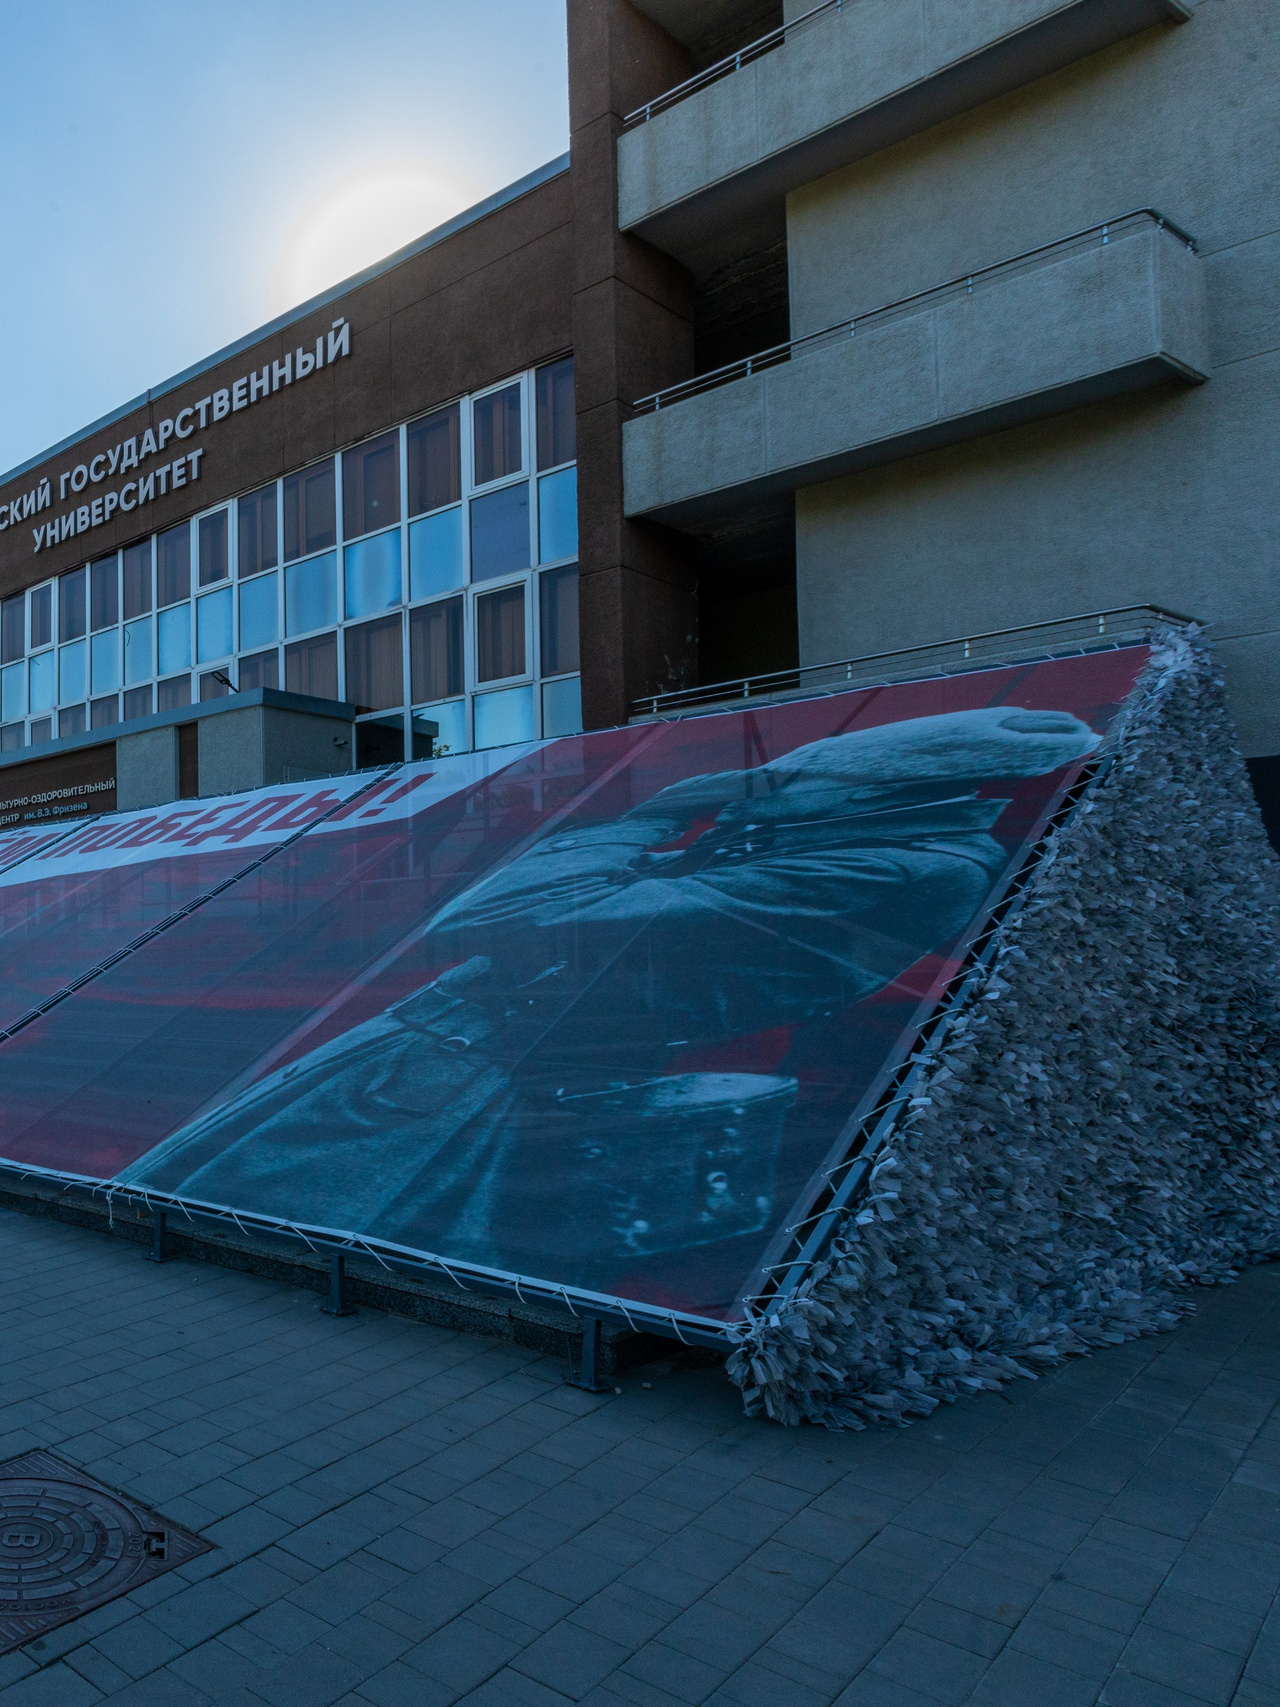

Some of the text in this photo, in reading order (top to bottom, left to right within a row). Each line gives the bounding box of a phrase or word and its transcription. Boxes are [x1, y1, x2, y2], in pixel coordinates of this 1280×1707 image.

[59, 317, 351, 501] ГОСУДАРСТВЕННЫЙ
[32, 448, 206, 554] УНИВЕРСИТЕТ
[24, 811, 36, 820] им.
[37, 807, 52, 817] В.Э.
[52, 801, 88, 816] Фризена
[35, 772, 438, 861] ПОБЕДЫ!
[127, 1531, 141, 1558] 2021
